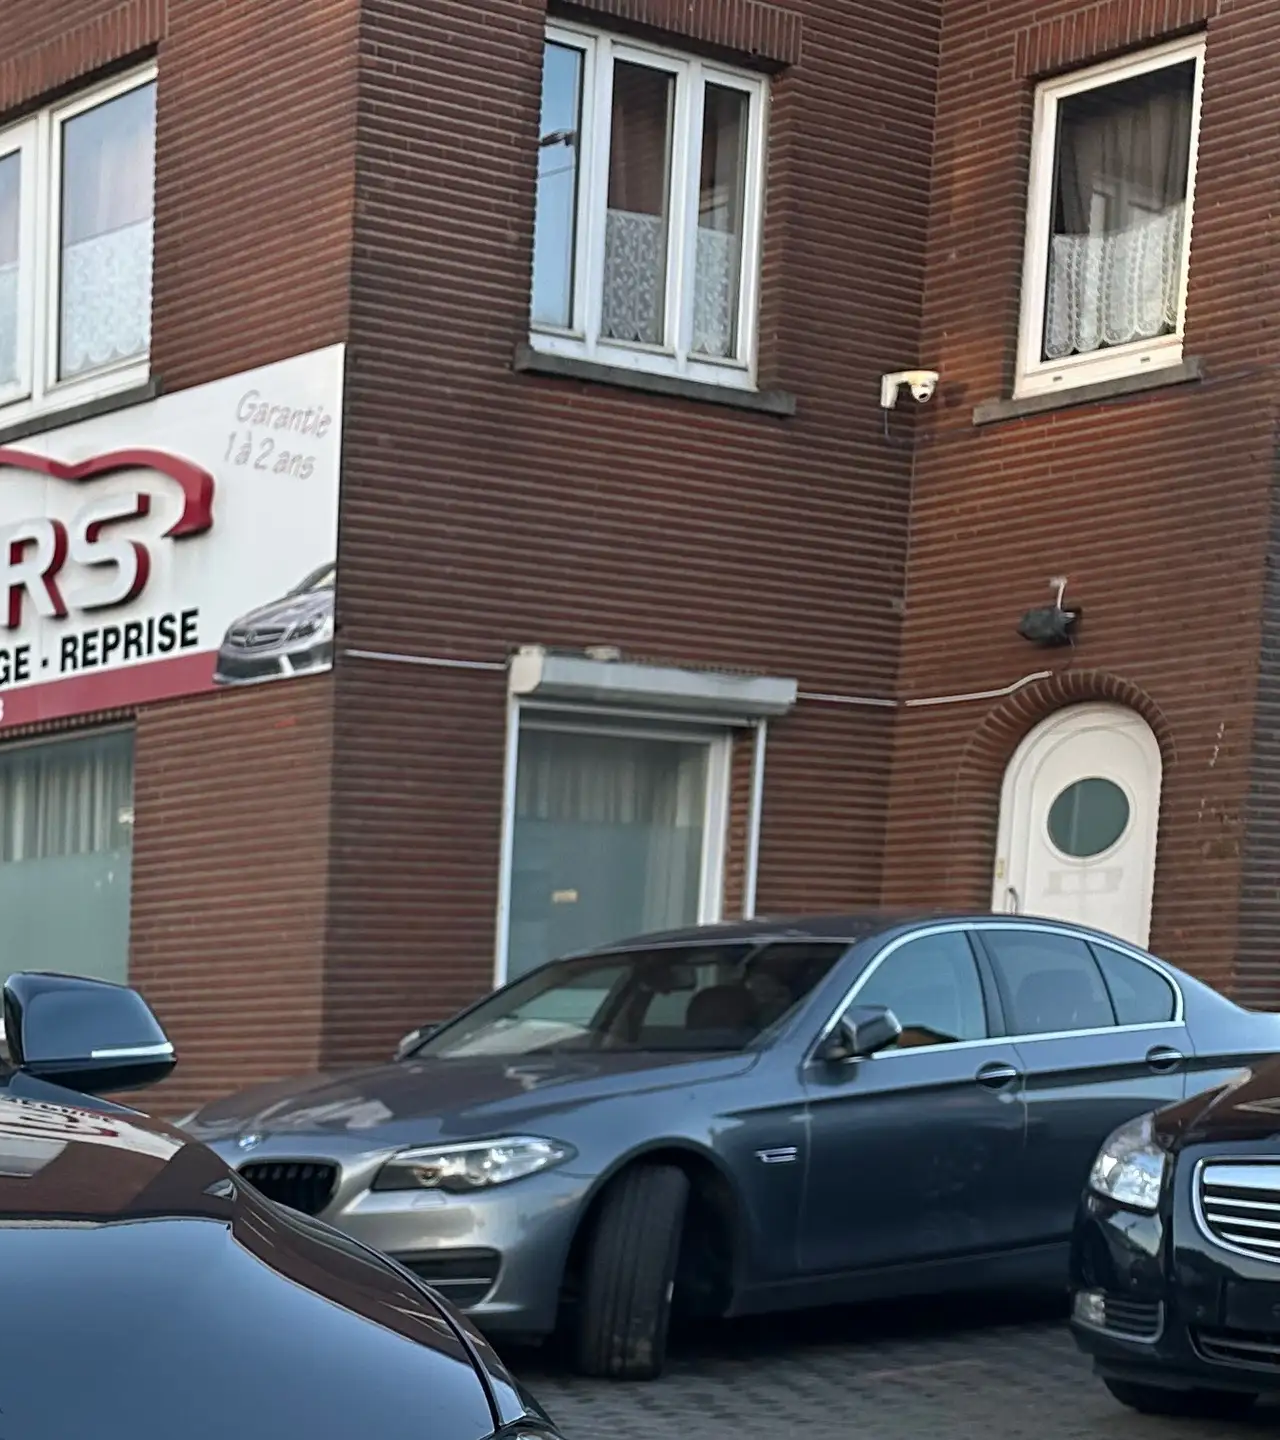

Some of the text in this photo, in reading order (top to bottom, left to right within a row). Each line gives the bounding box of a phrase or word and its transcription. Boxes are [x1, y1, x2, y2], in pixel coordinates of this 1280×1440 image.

[236, 389, 332, 438] Garantie
[253, 437, 275, 470] 2
[272, 450, 316, 480] ans
[59, 607, 200, 673] REPRISE
